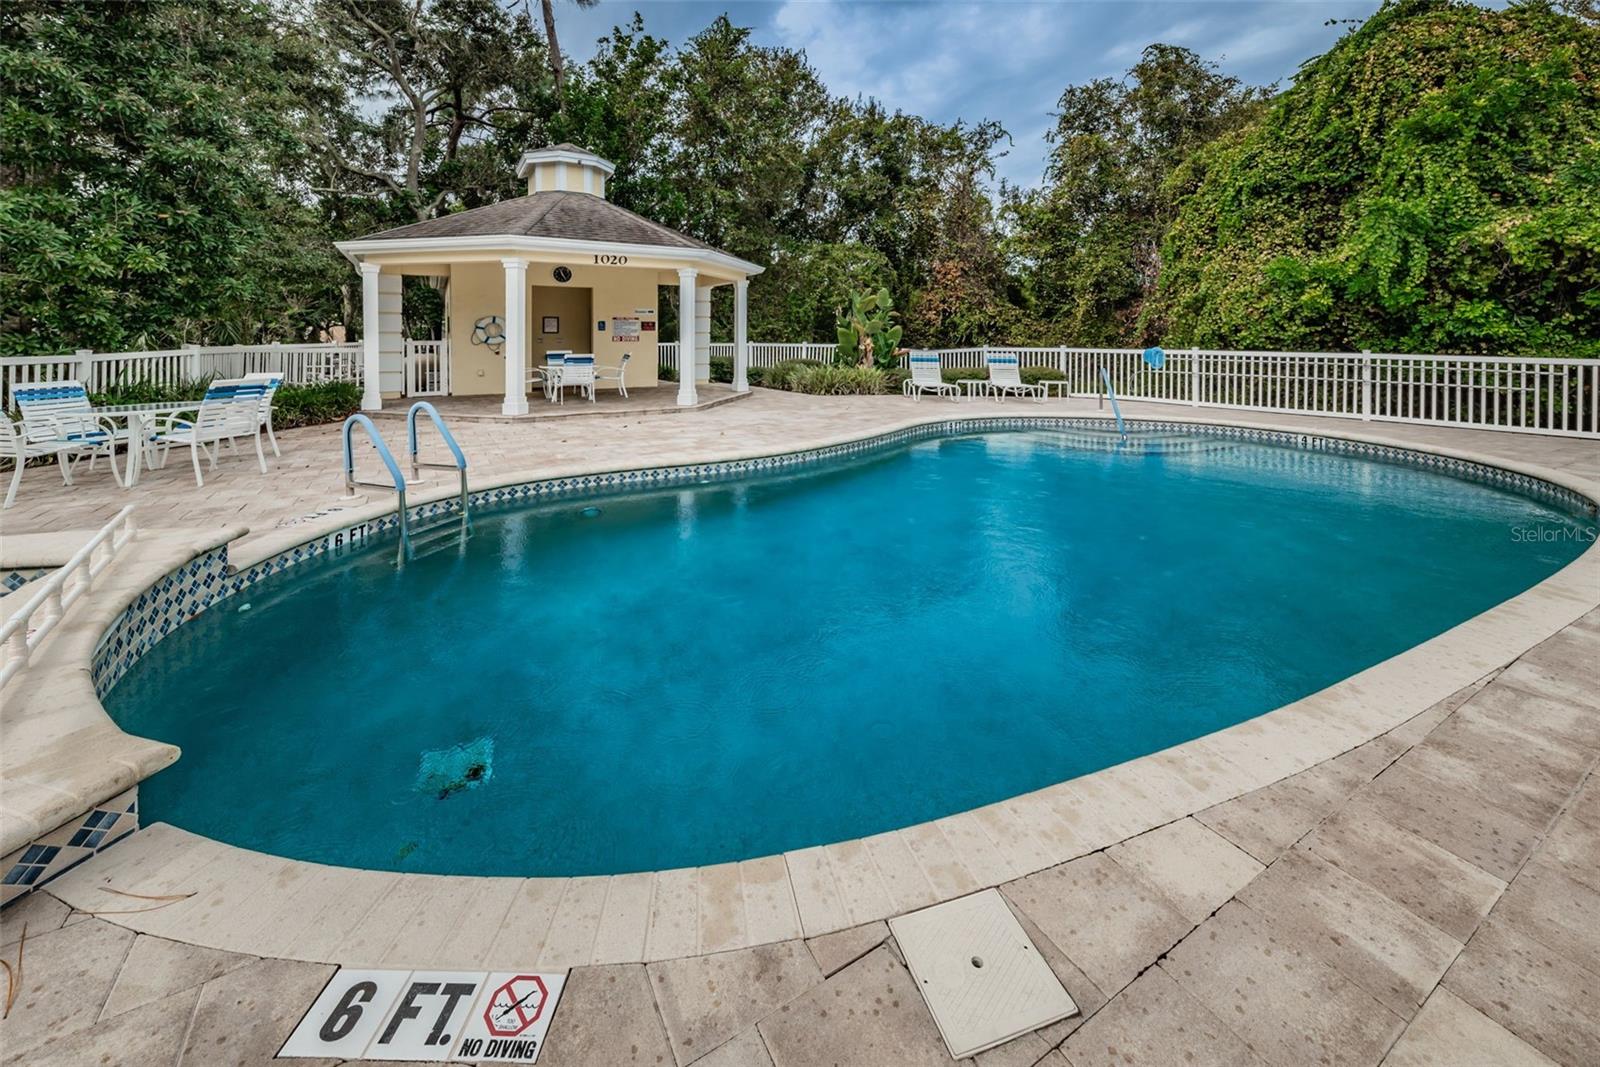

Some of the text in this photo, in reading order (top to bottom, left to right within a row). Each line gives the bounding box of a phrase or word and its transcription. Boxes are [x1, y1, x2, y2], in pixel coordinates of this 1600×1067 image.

[593, 254, 628, 265] 1020
[335, 524, 366, 547] 6 FT
[319, 980, 378, 1042] 6
[458, 1038, 537, 1059] NO DIVING
